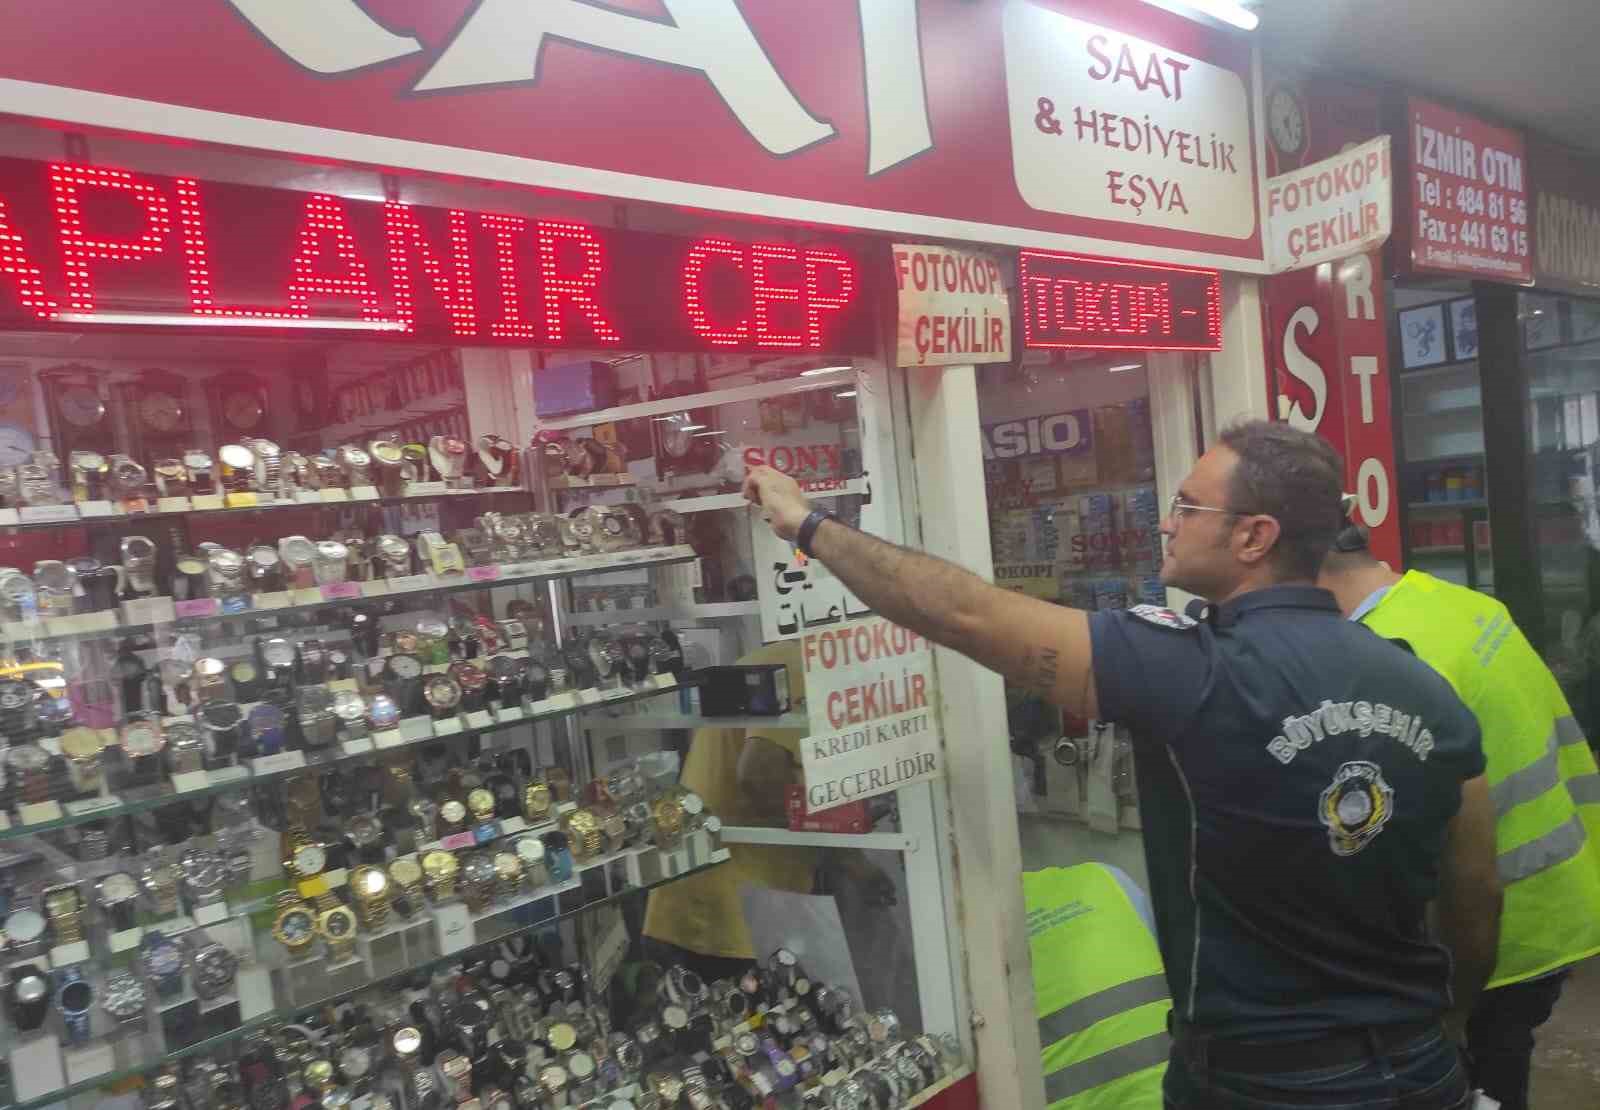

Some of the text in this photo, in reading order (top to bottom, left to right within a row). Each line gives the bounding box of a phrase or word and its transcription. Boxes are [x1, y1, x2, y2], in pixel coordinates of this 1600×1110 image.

[1086, 34, 1190, 102] SAAT
[1034, 96, 1237, 174] & HEDİYELİK
[1415, 112, 1523, 192] İZMİR OTM
[1106, 170, 1189, 216] EŞYA
[1416, 172, 1441, 207] Tel
[1455, 185, 1484, 216] 484
[1418, 209, 1448, 243] Fax
[1460, 219, 1487, 249] 441
[684, 240, 853, 346] CEP
[915, 307, 1004, 364] ÇEKİLİR
[743, 446, 842, 477] SONY
[813, 714, 928, 760] KREDİ KARTI
